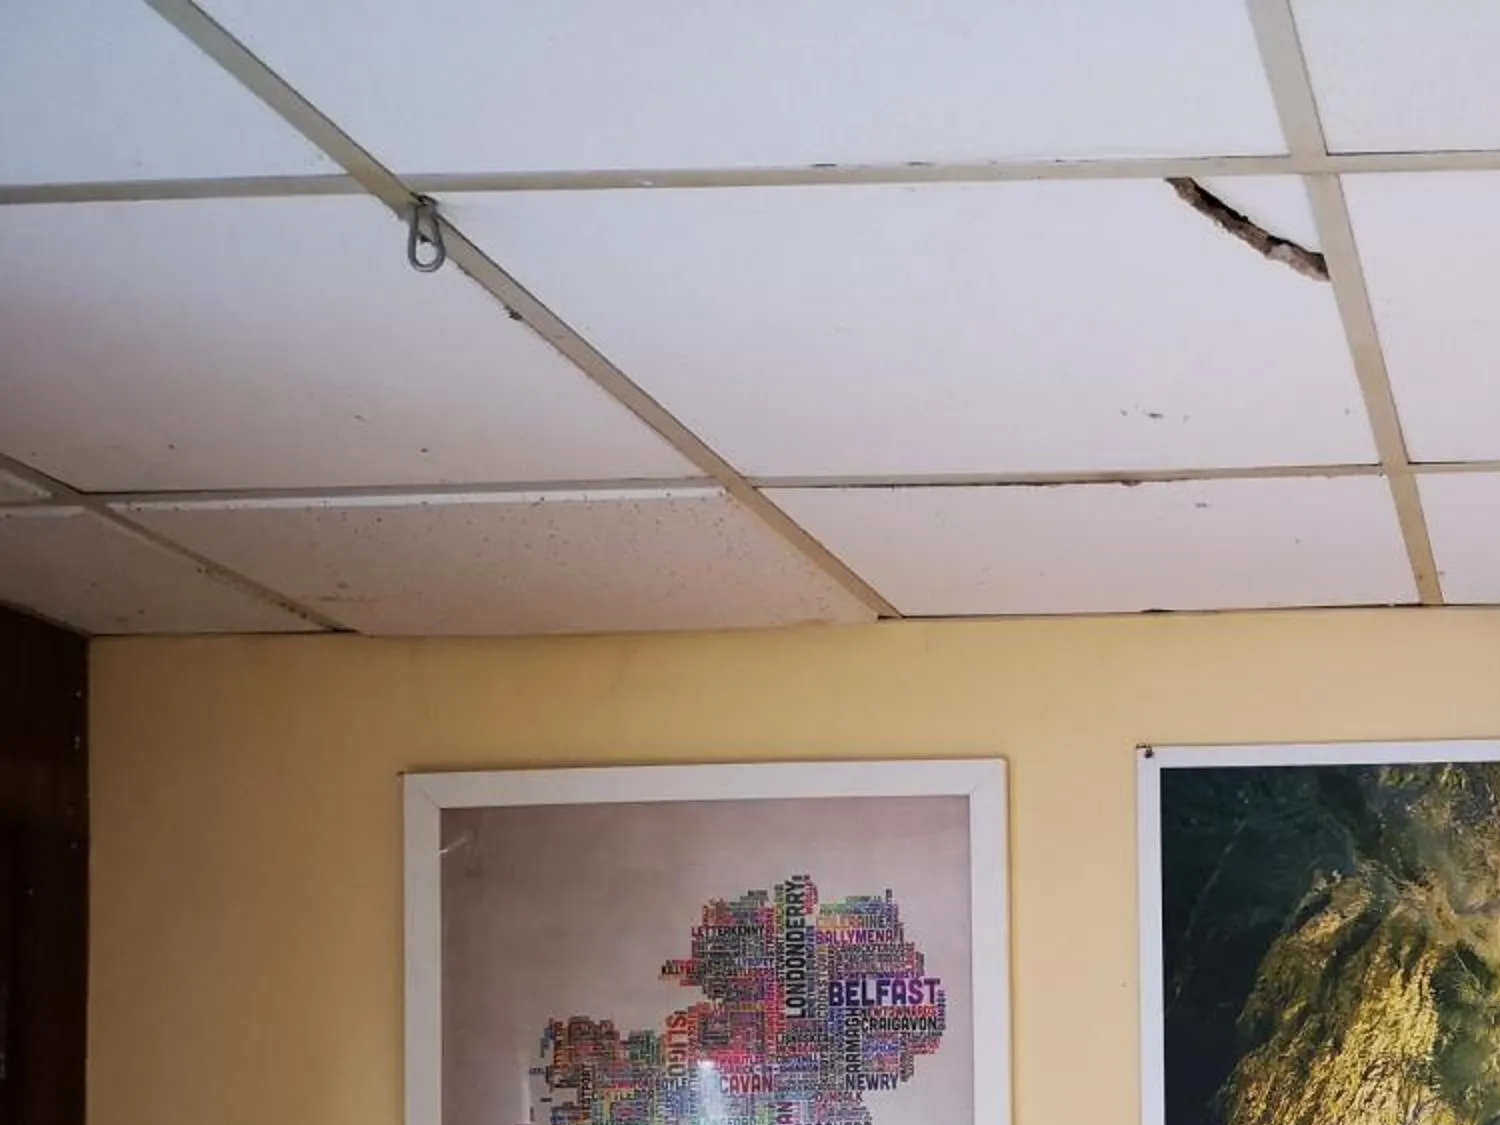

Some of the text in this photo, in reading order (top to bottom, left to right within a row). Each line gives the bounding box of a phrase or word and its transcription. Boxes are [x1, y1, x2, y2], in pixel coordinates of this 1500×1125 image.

[691, 926, 764, 938] LETTERKENNY
[816, 928, 894, 945] BALLYMENA
[785, 880, 806, 1019] LONDONDERRY
[828, 978, 941, 1006] BELFAST
[861, 1017, 937, 1032] CRAIGAVON
[666, 1014, 688, 1077] SLIGO
[845, 1007, 861, 1073] ARMAGH
[719, 1074, 773, 1094] CAVAN
[845, 1073, 899, 1092] NEWRY
